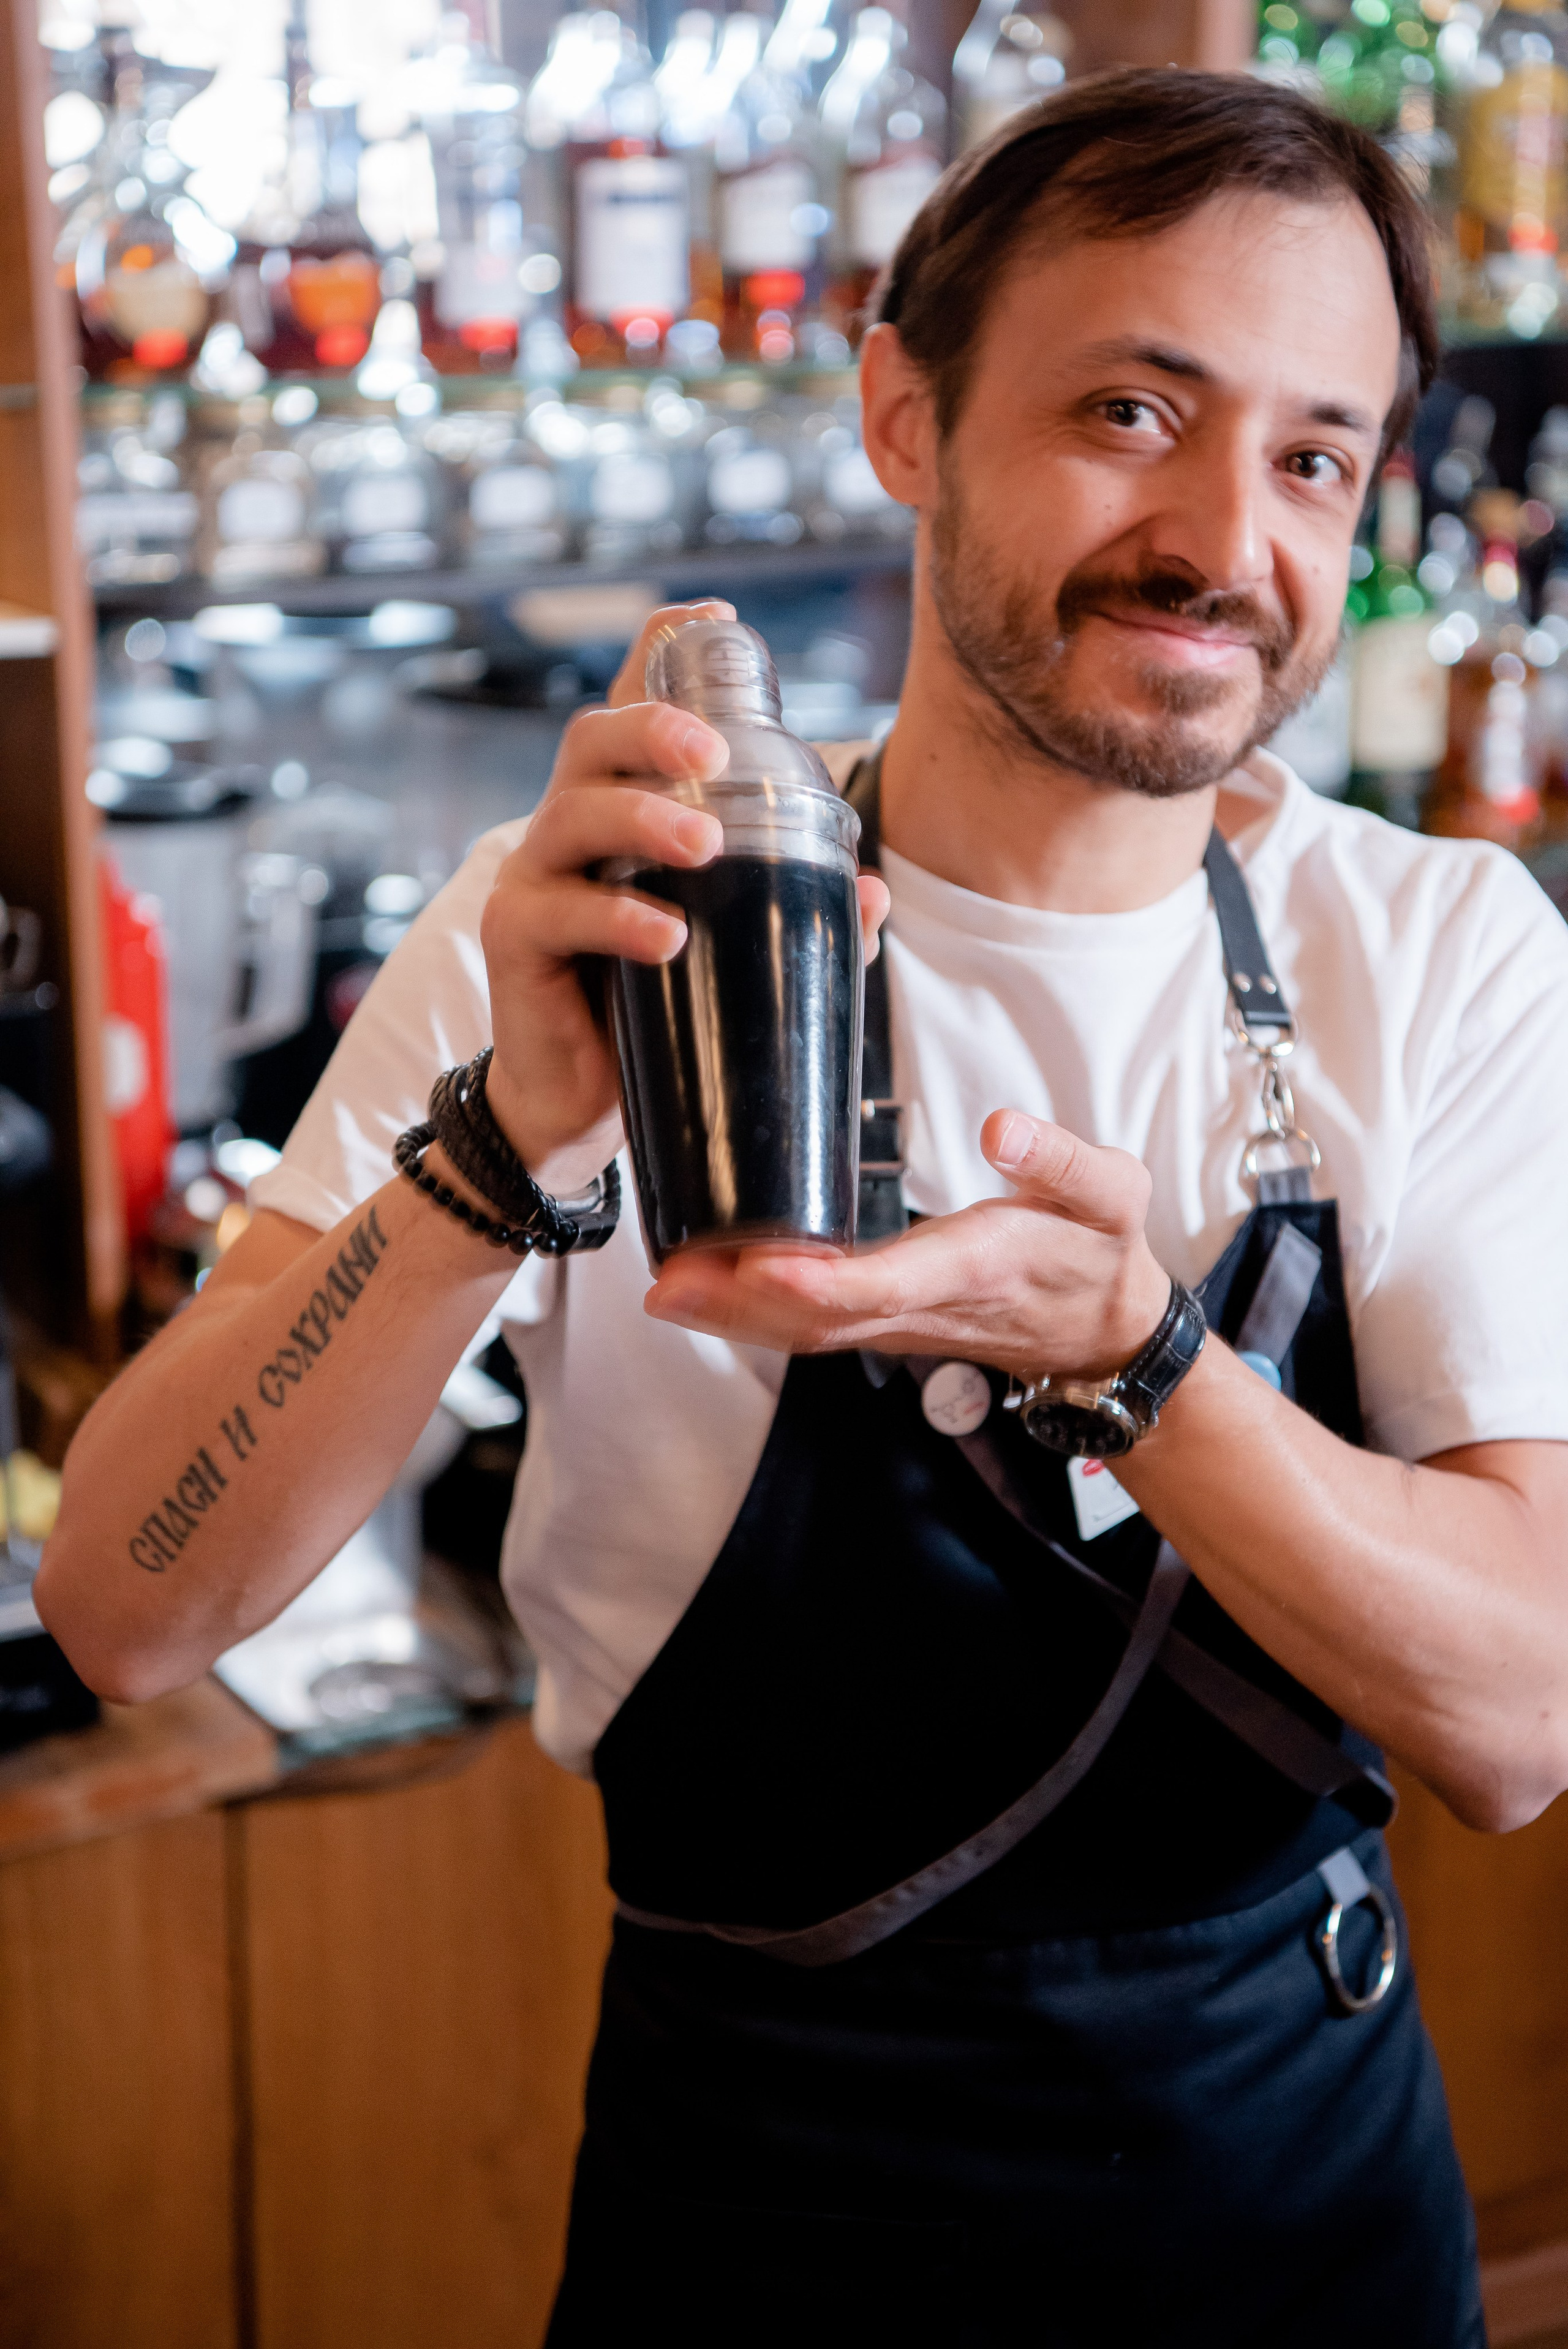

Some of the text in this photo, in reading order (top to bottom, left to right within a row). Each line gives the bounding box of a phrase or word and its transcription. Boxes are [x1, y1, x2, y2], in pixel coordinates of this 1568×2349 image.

[129, 1205, 388, 1572] СПАСИ И СОХРАНИ
